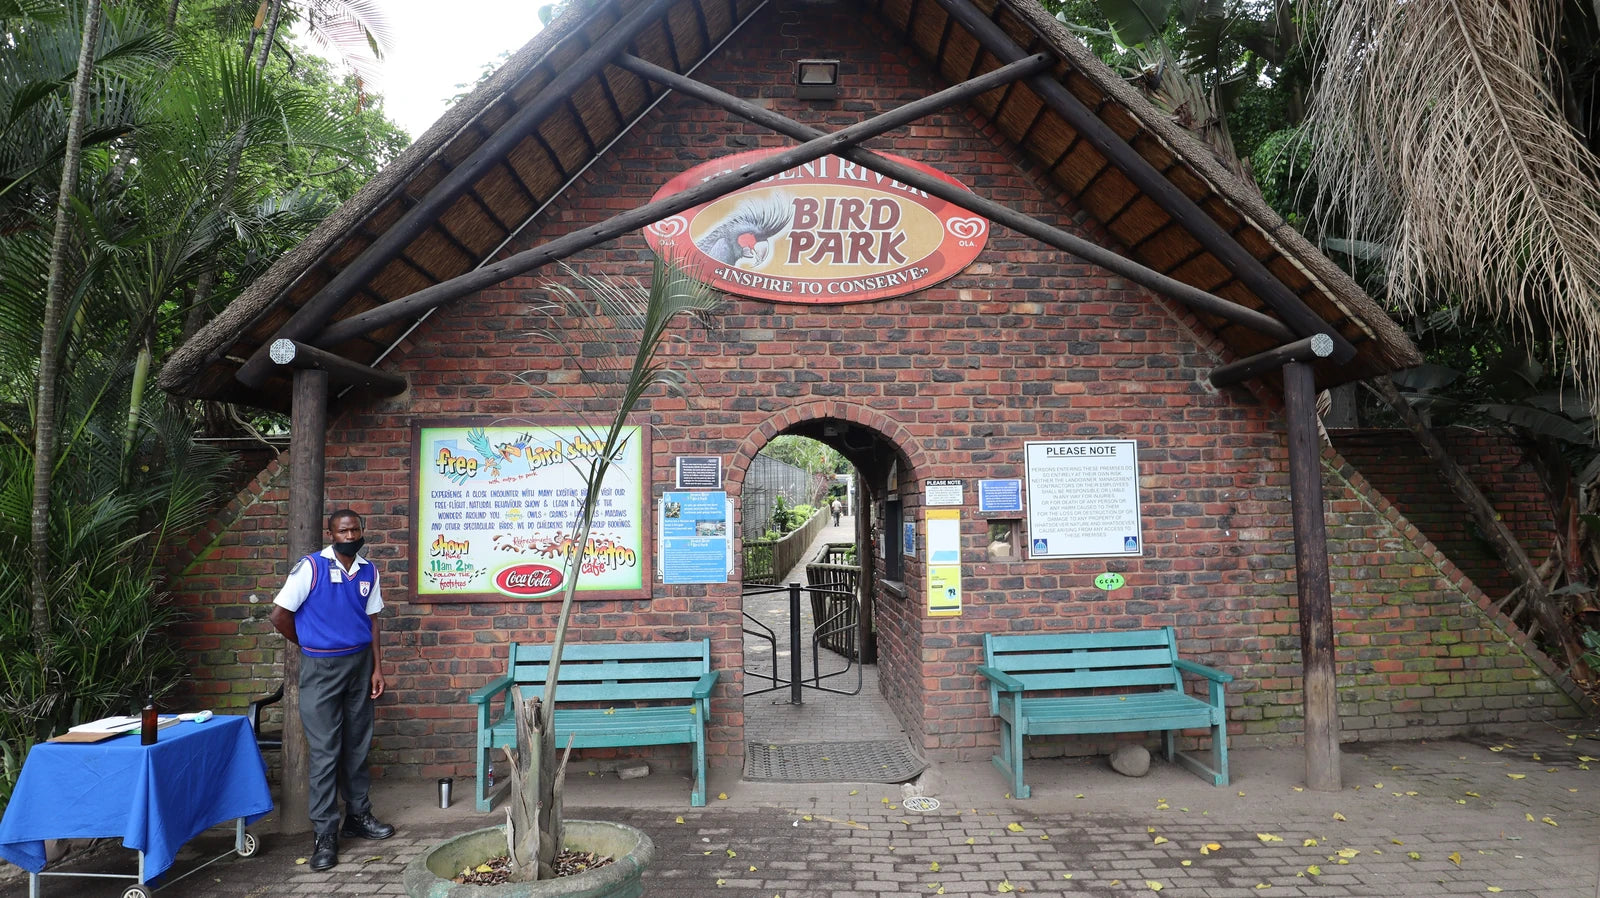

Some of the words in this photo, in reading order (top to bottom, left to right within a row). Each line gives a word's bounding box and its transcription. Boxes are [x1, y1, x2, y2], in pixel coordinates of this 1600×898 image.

[792, 198, 902, 230] BIRD
[785, 230, 908, 265] PARK
[798, 282, 822, 294] TO
[1046, 447, 1086, 455] PLEASE
[1090, 446, 1116, 454] NOTE
[436, 448, 478, 478] free
[525, 440, 562, 471] bird
[431, 490, 462, 498] EXPERIENCE
[556, 488, 578, 496] EXCITING
[601, 488, 612, 496] VISIT
[495, 499, 522, 508] BEHAVIOUR
[430, 534, 469, 556] show
[431, 560, 452, 571] 11am
[456, 560, 474, 572] 2pm
[582, 558, 606, 576] cafe
[440, 578, 466, 590] footsteps
